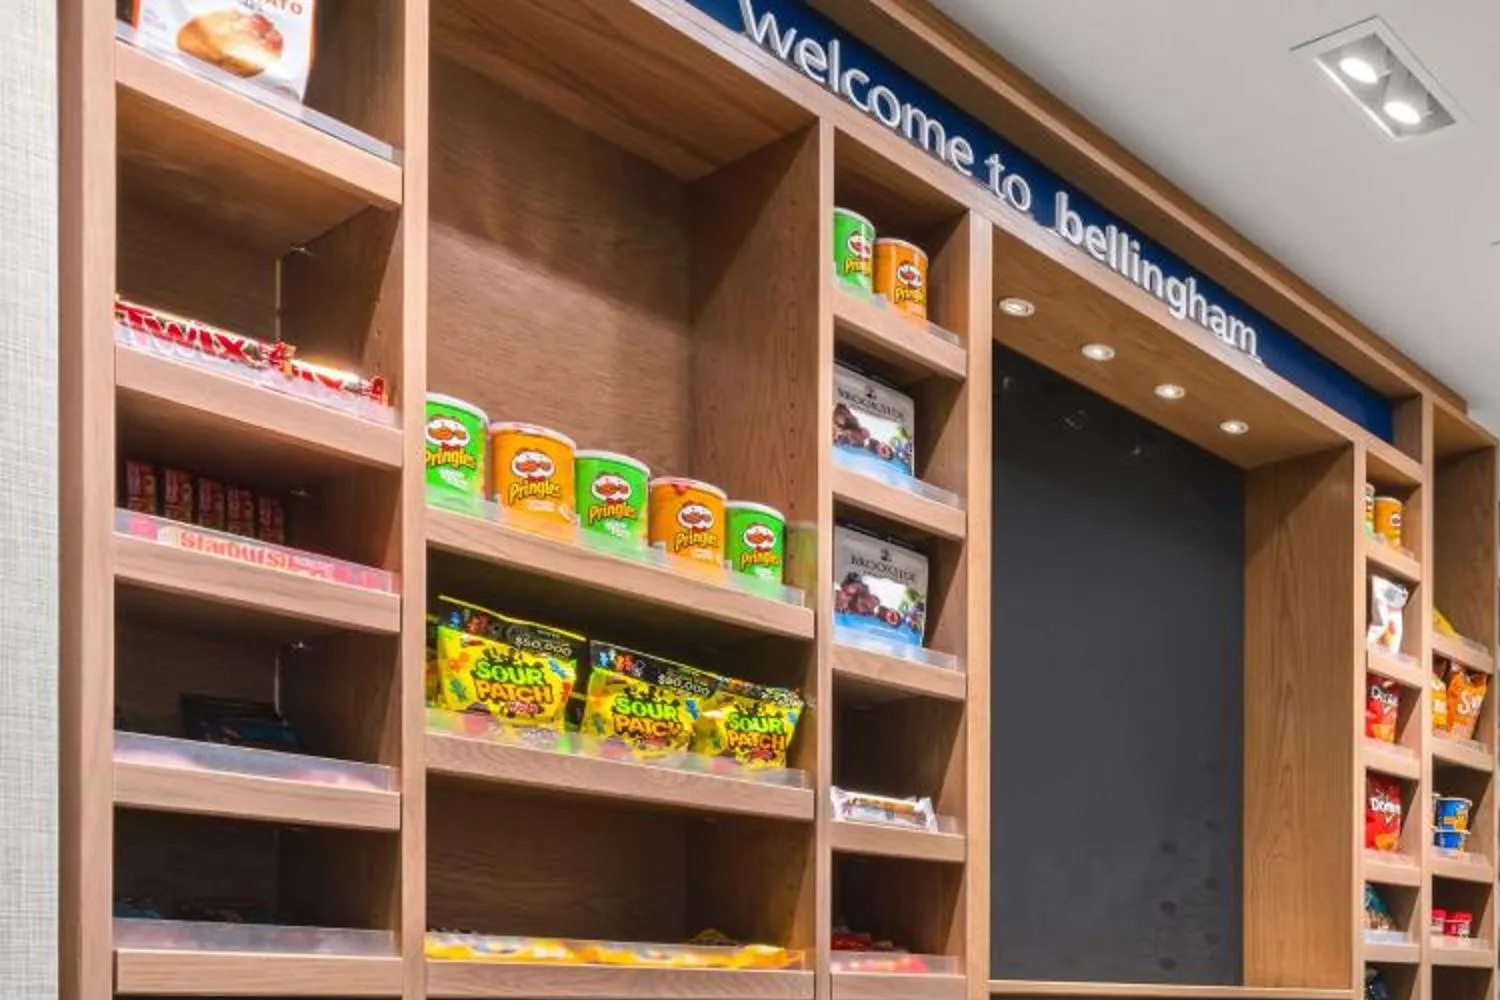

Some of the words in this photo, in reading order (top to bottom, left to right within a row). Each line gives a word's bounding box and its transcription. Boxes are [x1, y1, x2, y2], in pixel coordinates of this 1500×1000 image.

[740, 0, 974, 176] welcome
[984, 152, 1032, 213] to
[1054, 191, 1258, 358] bellingham
[508, 479, 563, 507] Pringles
[472, 660, 546, 687] SOUR
[474, 678, 554, 703] PATCH
[612, 695, 680, 721] SOUR
[727, 710, 785, 734] SOUR
[726, 729, 788, 751] PATCH
